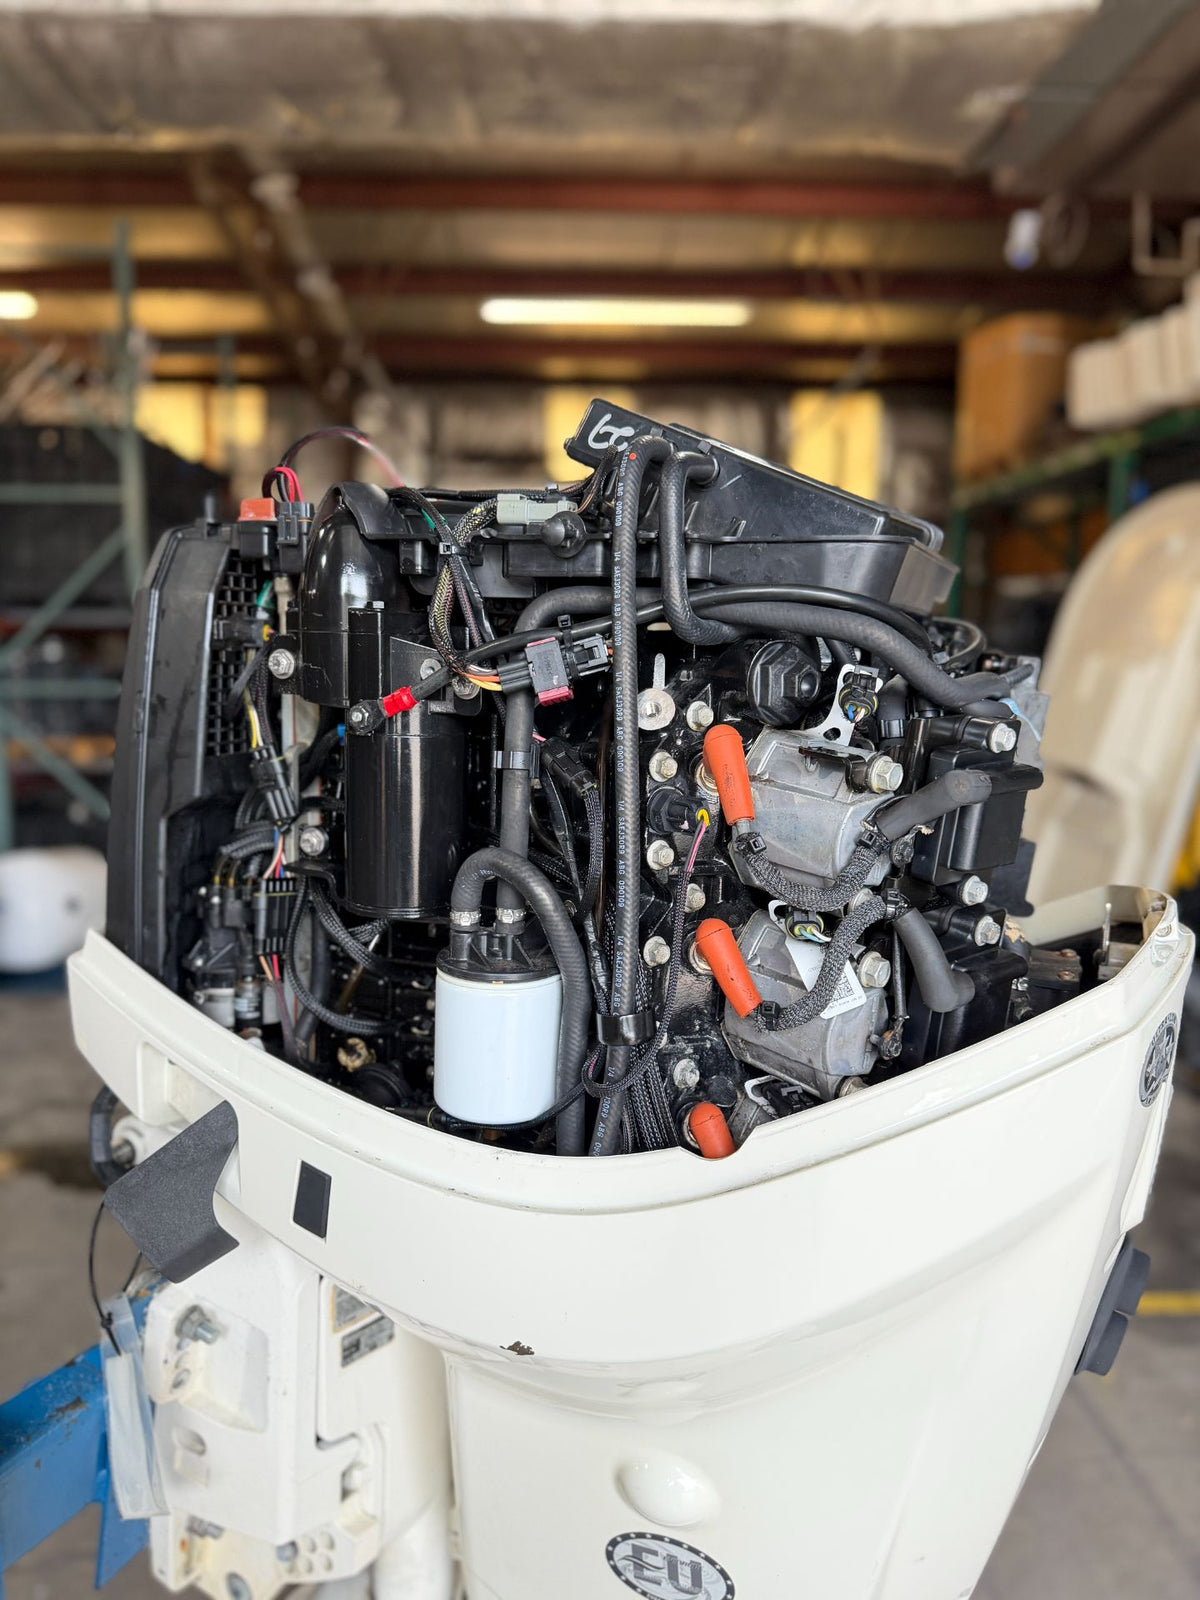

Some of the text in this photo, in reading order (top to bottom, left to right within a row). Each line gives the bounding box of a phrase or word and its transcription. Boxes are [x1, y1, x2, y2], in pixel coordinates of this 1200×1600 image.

[618, 800, 626, 811] 1/4
[614, 951, 623, 988] SAEJ30R9
[613, 991, 621, 1007] ABG
[607, 1066, 615, 1078] 1/4
